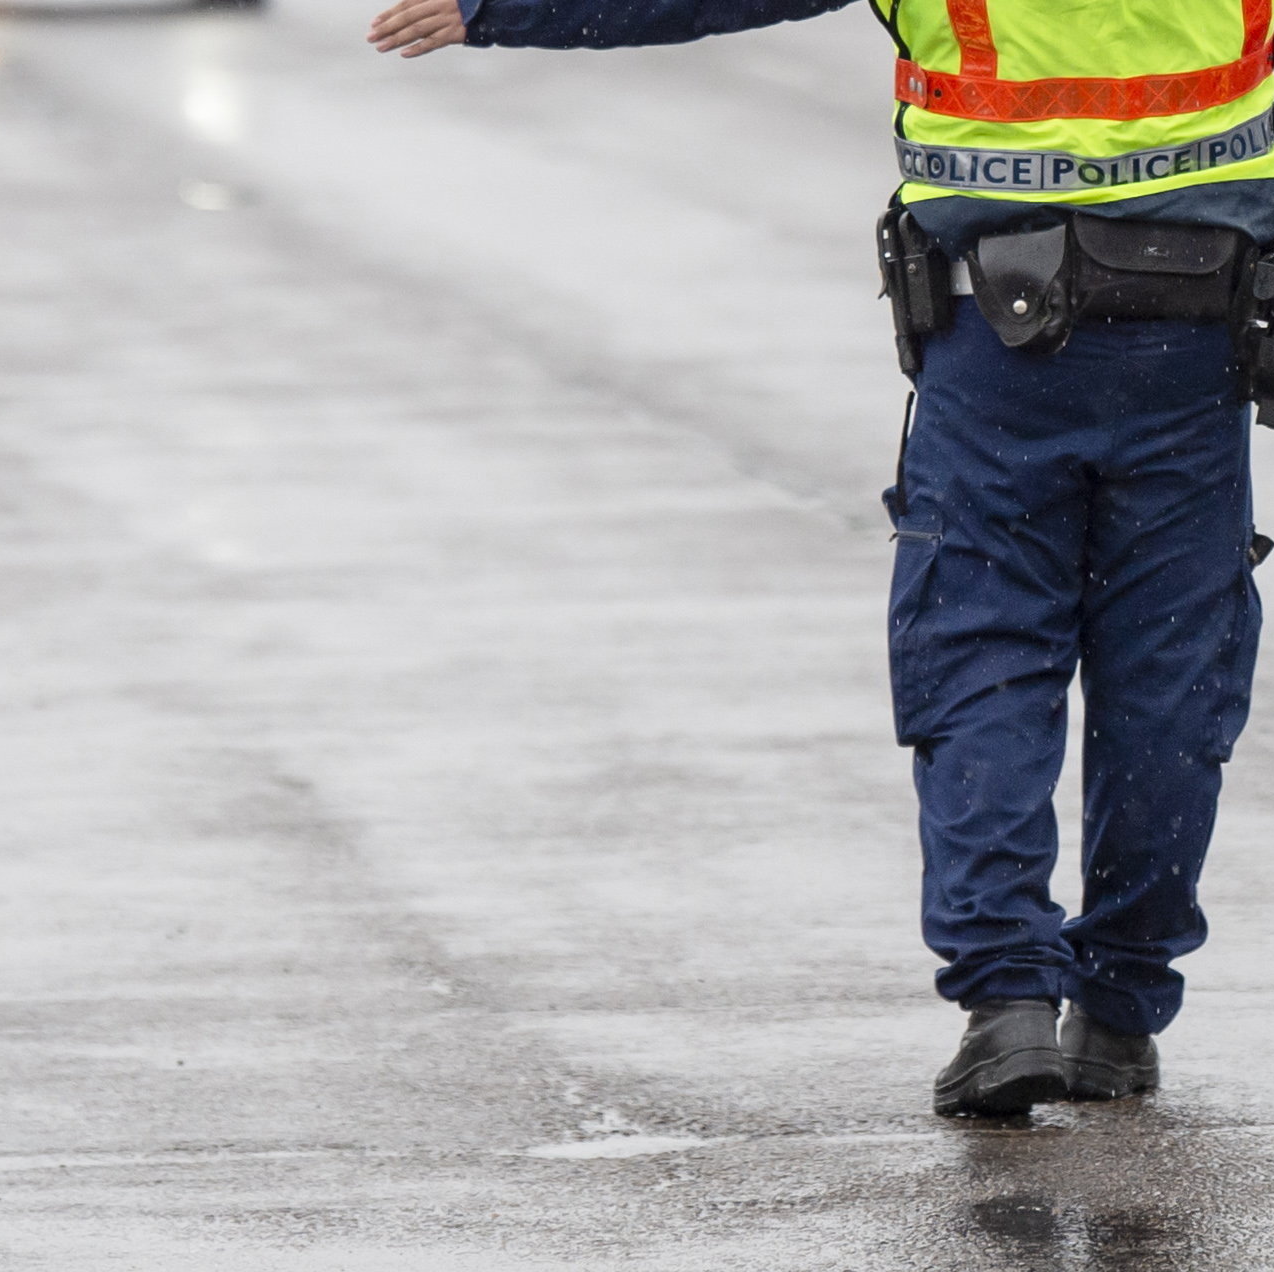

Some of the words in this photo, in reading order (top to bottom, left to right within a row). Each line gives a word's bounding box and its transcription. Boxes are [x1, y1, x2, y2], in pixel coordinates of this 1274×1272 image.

[927, 152, 1032, 185] OLICE
[1052, 148, 1192, 187] POLICE
[1208, 120, 1272, 174] POLI
